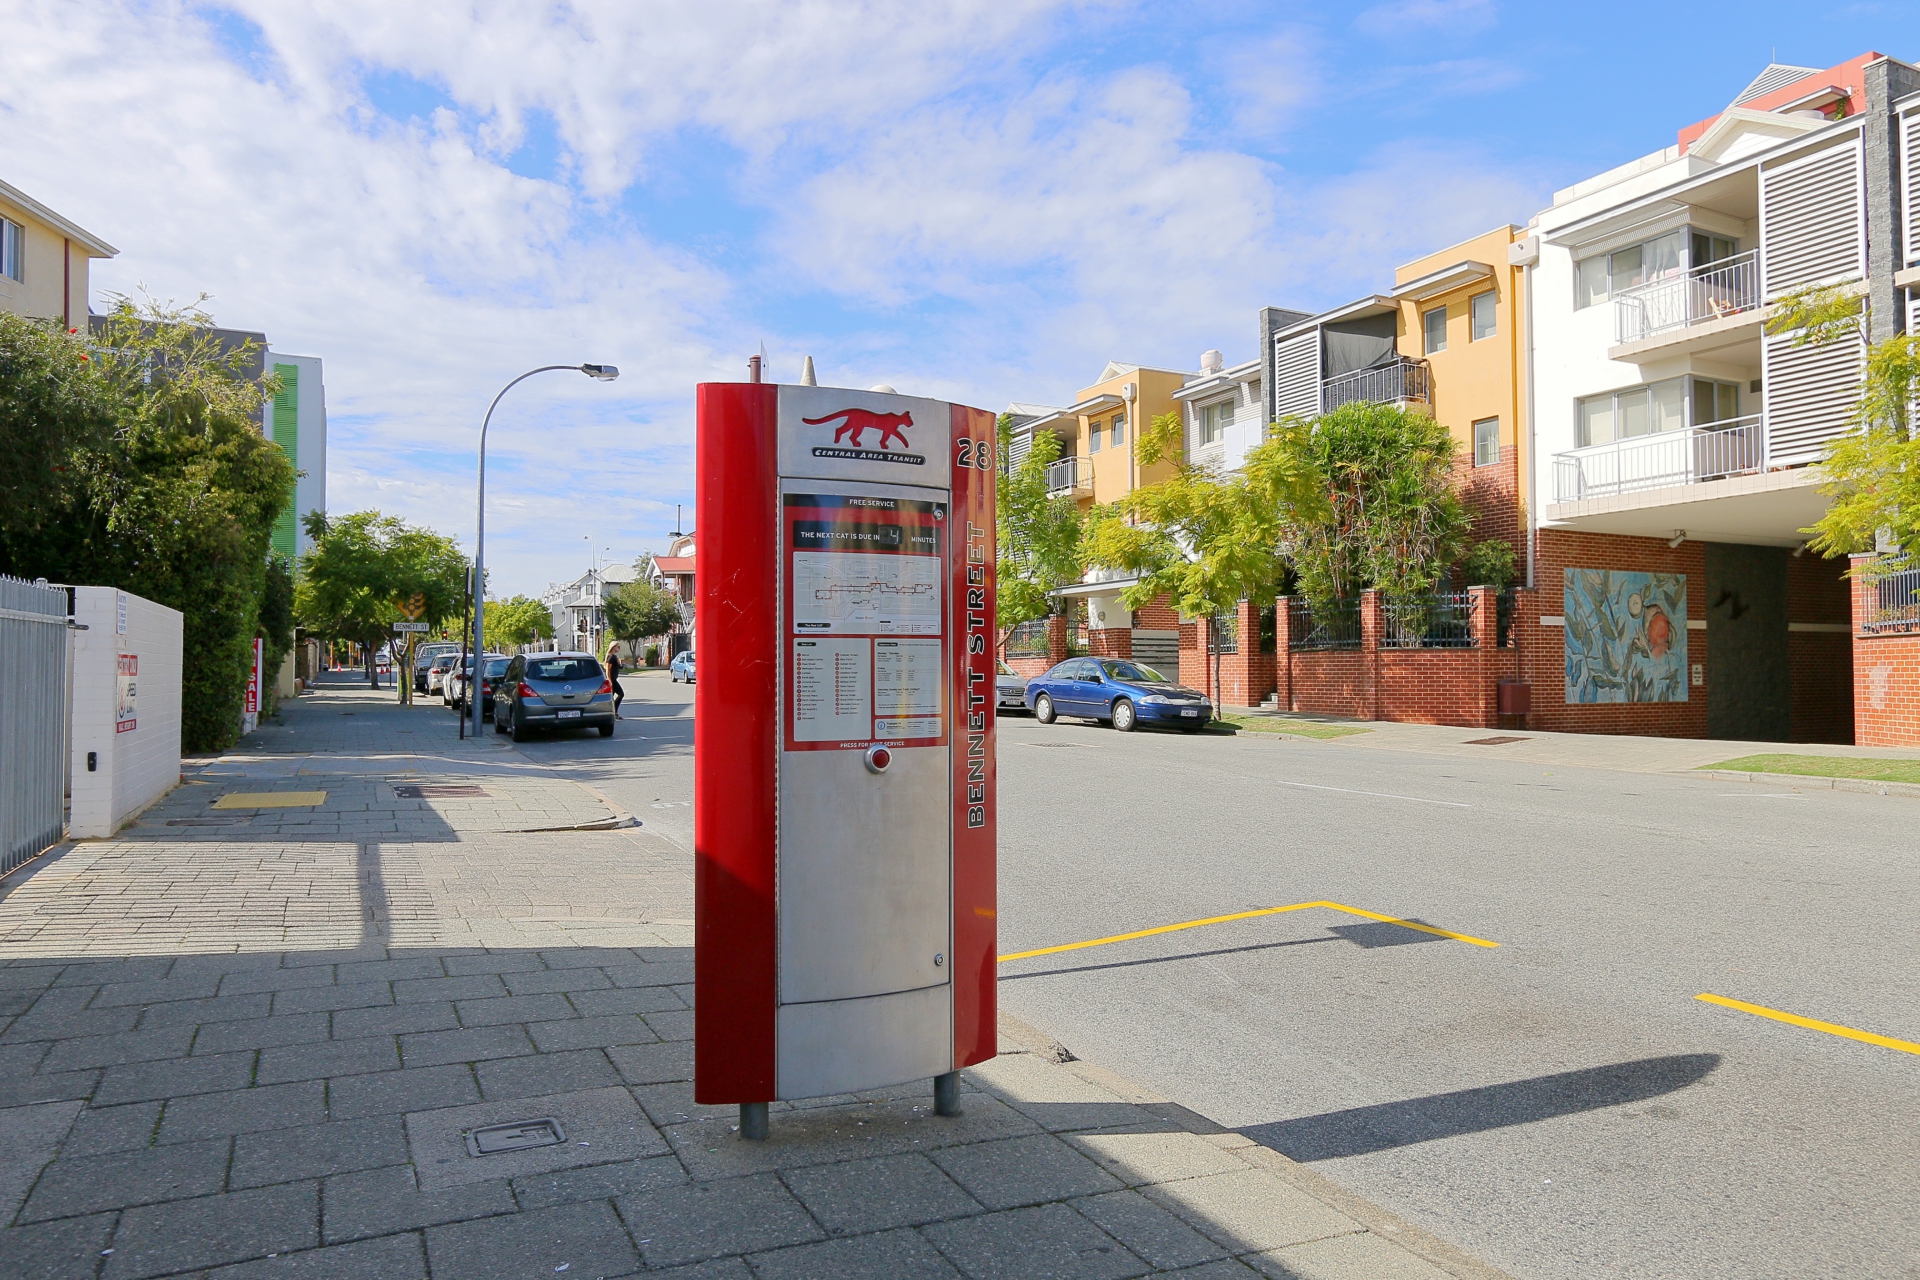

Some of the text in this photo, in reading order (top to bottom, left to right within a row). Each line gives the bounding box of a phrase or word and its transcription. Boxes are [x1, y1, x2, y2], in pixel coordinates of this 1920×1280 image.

[815, 449, 922, 464] CENTRAL AREA TRANSIT
[957, 437, 992, 471] 28
[868, 500, 895, 508] SERVICE
[800, 531, 815, 539] THE
[858, 533, 872, 541] DUE
[911, 536, 936, 544] MINUTES
[967, 520, 985, 829] BENNETT STREET
